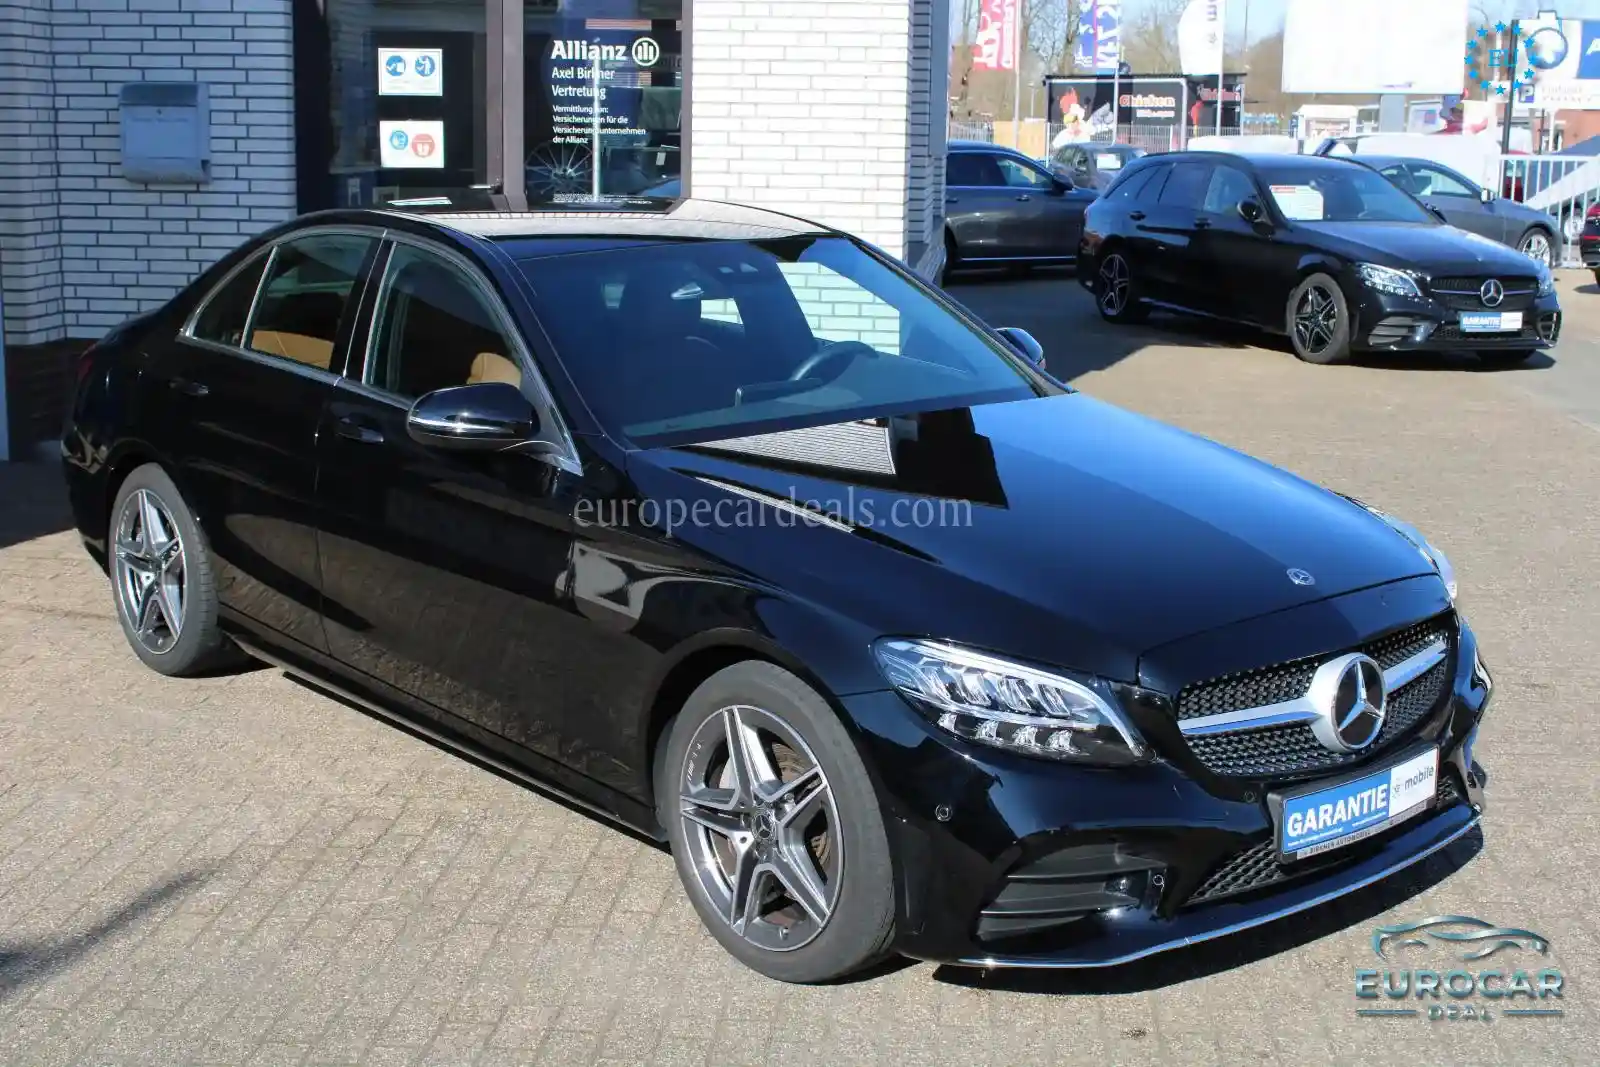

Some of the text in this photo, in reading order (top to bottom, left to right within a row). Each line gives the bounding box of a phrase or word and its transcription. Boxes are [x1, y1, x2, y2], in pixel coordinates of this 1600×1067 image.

[551, 40, 627, 60] Allianz
[552, 67, 574, 79] Axel
[551, 85, 606, 100] Vertretung
[552, 105, 593, 115] Vermittlung
[552, 115, 629, 124] Versicherunn für die
[552, 126, 646, 135] Versicherungunternehmen
[552, 136, 589, 144] der Allianz
[1404, 765, 1435, 791] mobile
[1287, 783, 1389, 837] GARANTIE
